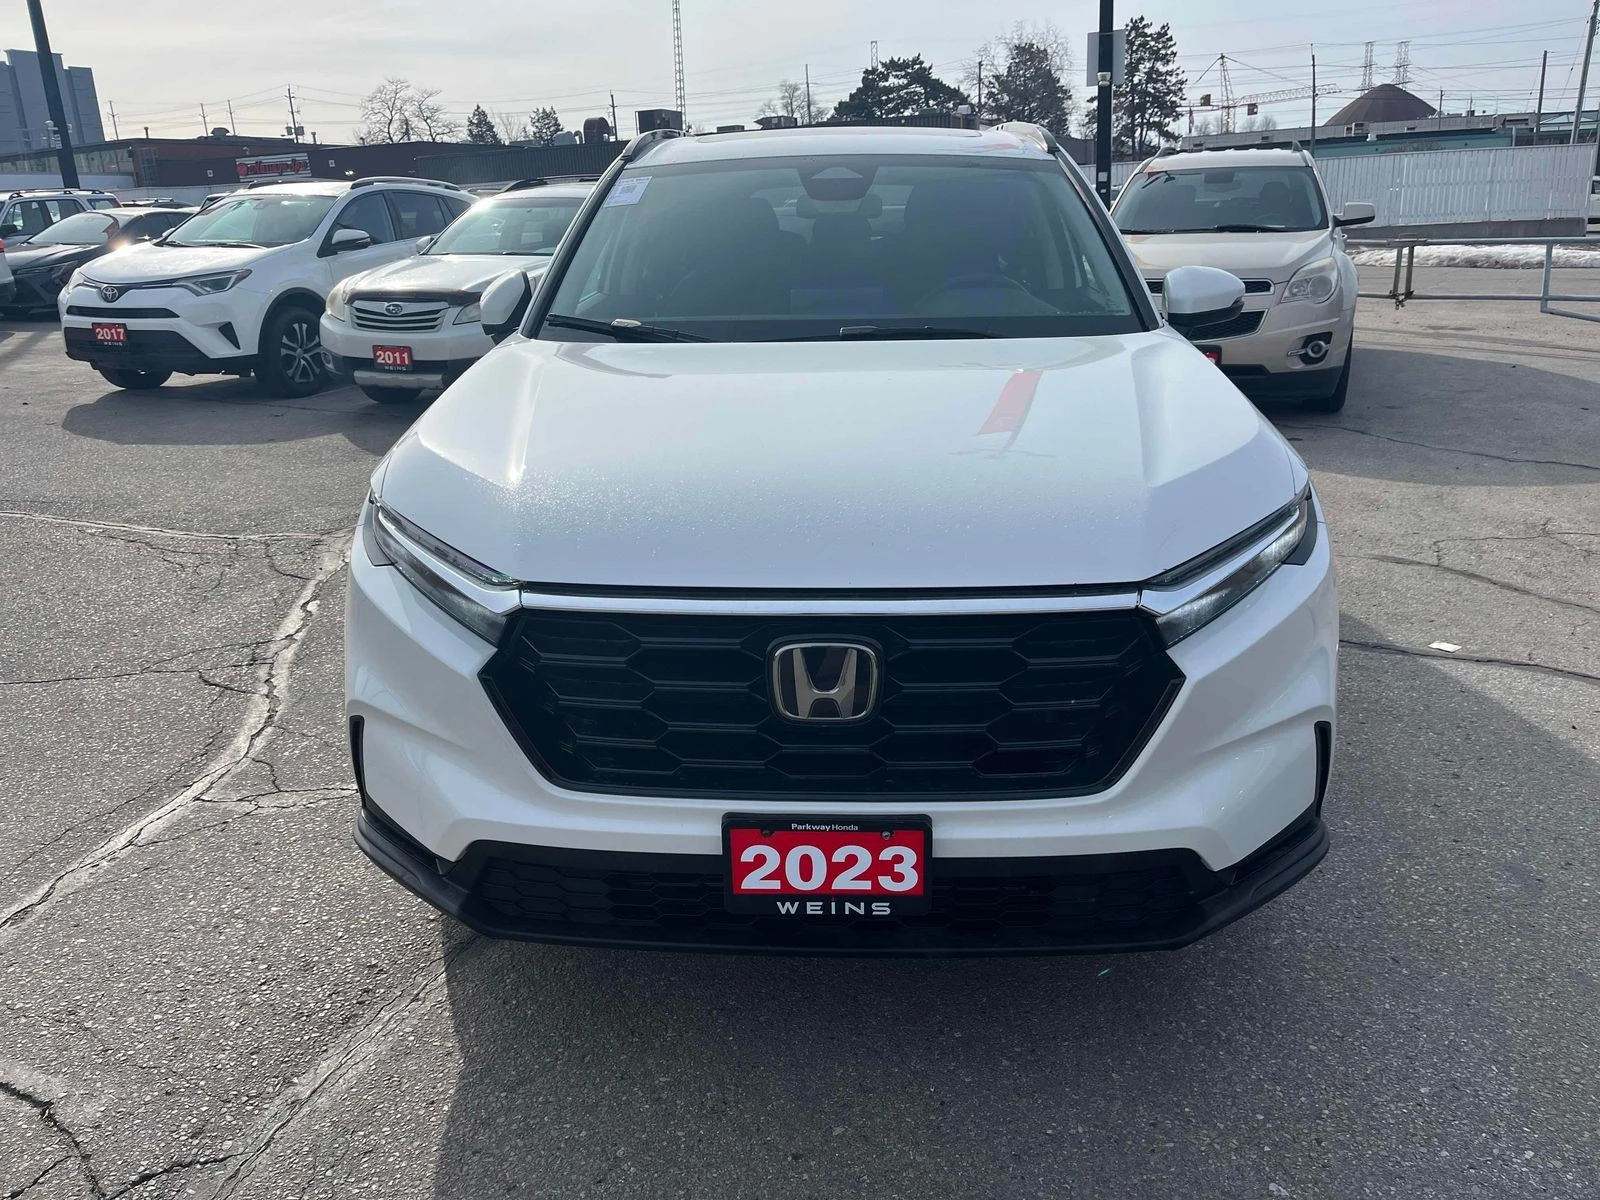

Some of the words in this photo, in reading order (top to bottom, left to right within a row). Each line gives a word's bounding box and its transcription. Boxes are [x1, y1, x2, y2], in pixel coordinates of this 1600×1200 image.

[96, 328, 125, 340] 2017
[376, 350, 409, 365] 2011
[791, 823, 831, 832] Parkway
[740, 844, 919, 892] 2023
[776, 901, 891, 915] WEINS
